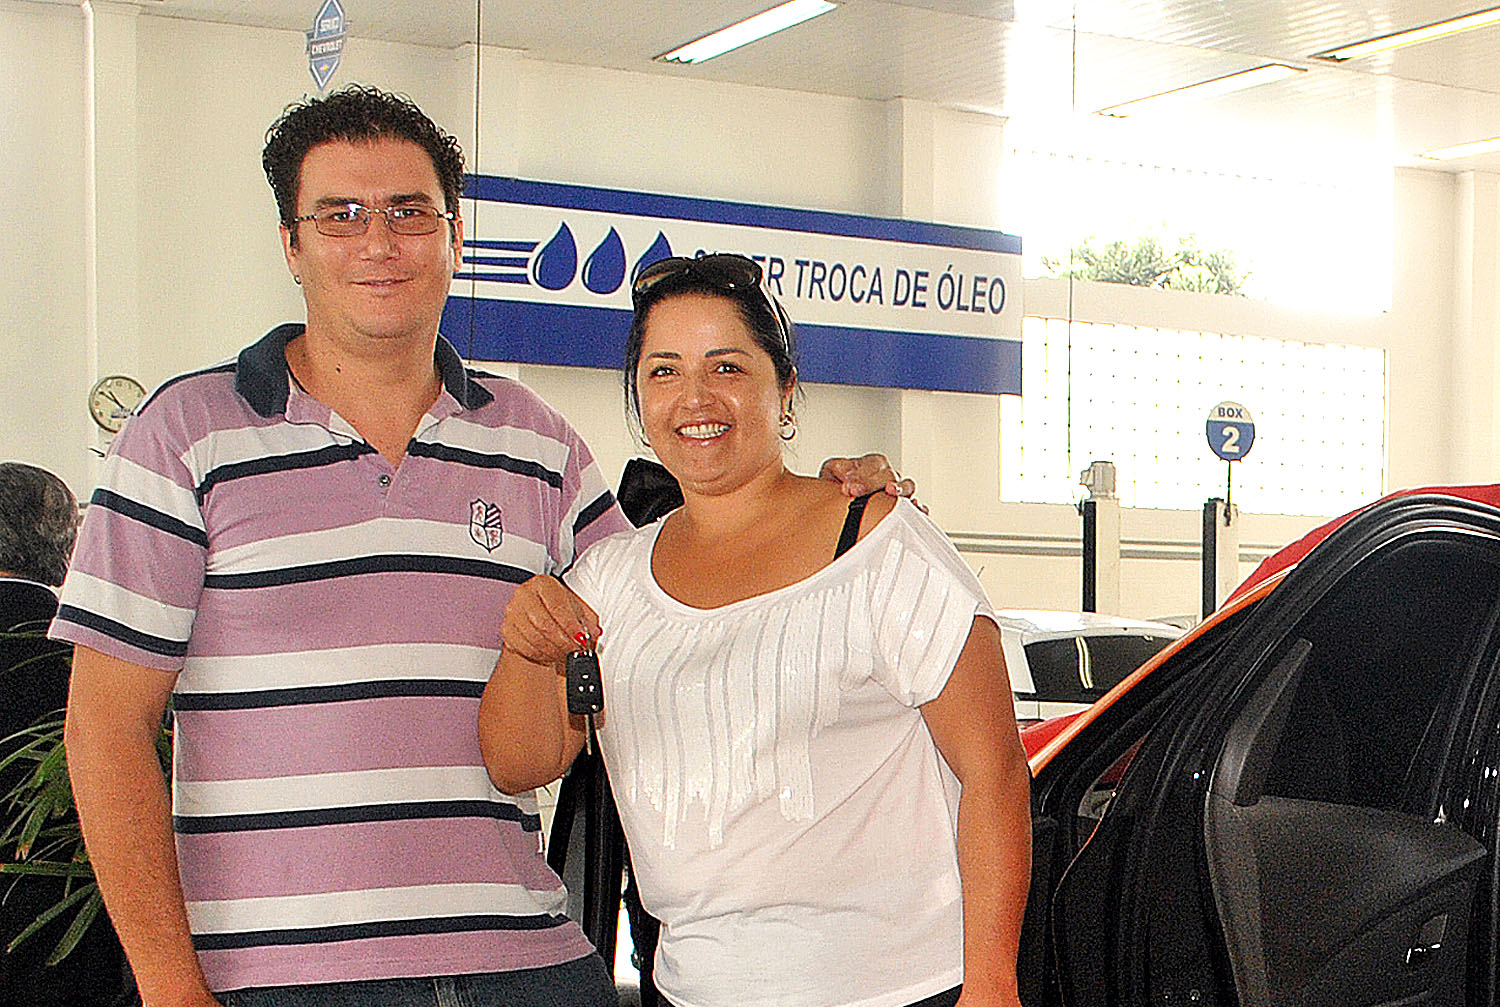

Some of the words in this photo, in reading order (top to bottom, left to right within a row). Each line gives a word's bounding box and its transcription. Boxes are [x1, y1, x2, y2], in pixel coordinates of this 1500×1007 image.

[795, 260, 883, 305] TROCA
[893, 269, 929, 308] DE
[937, 264, 1006, 315] ÓLEO
[1218, 407, 1243, 418] BOX
[1222, 426, 1240, 453] 2
